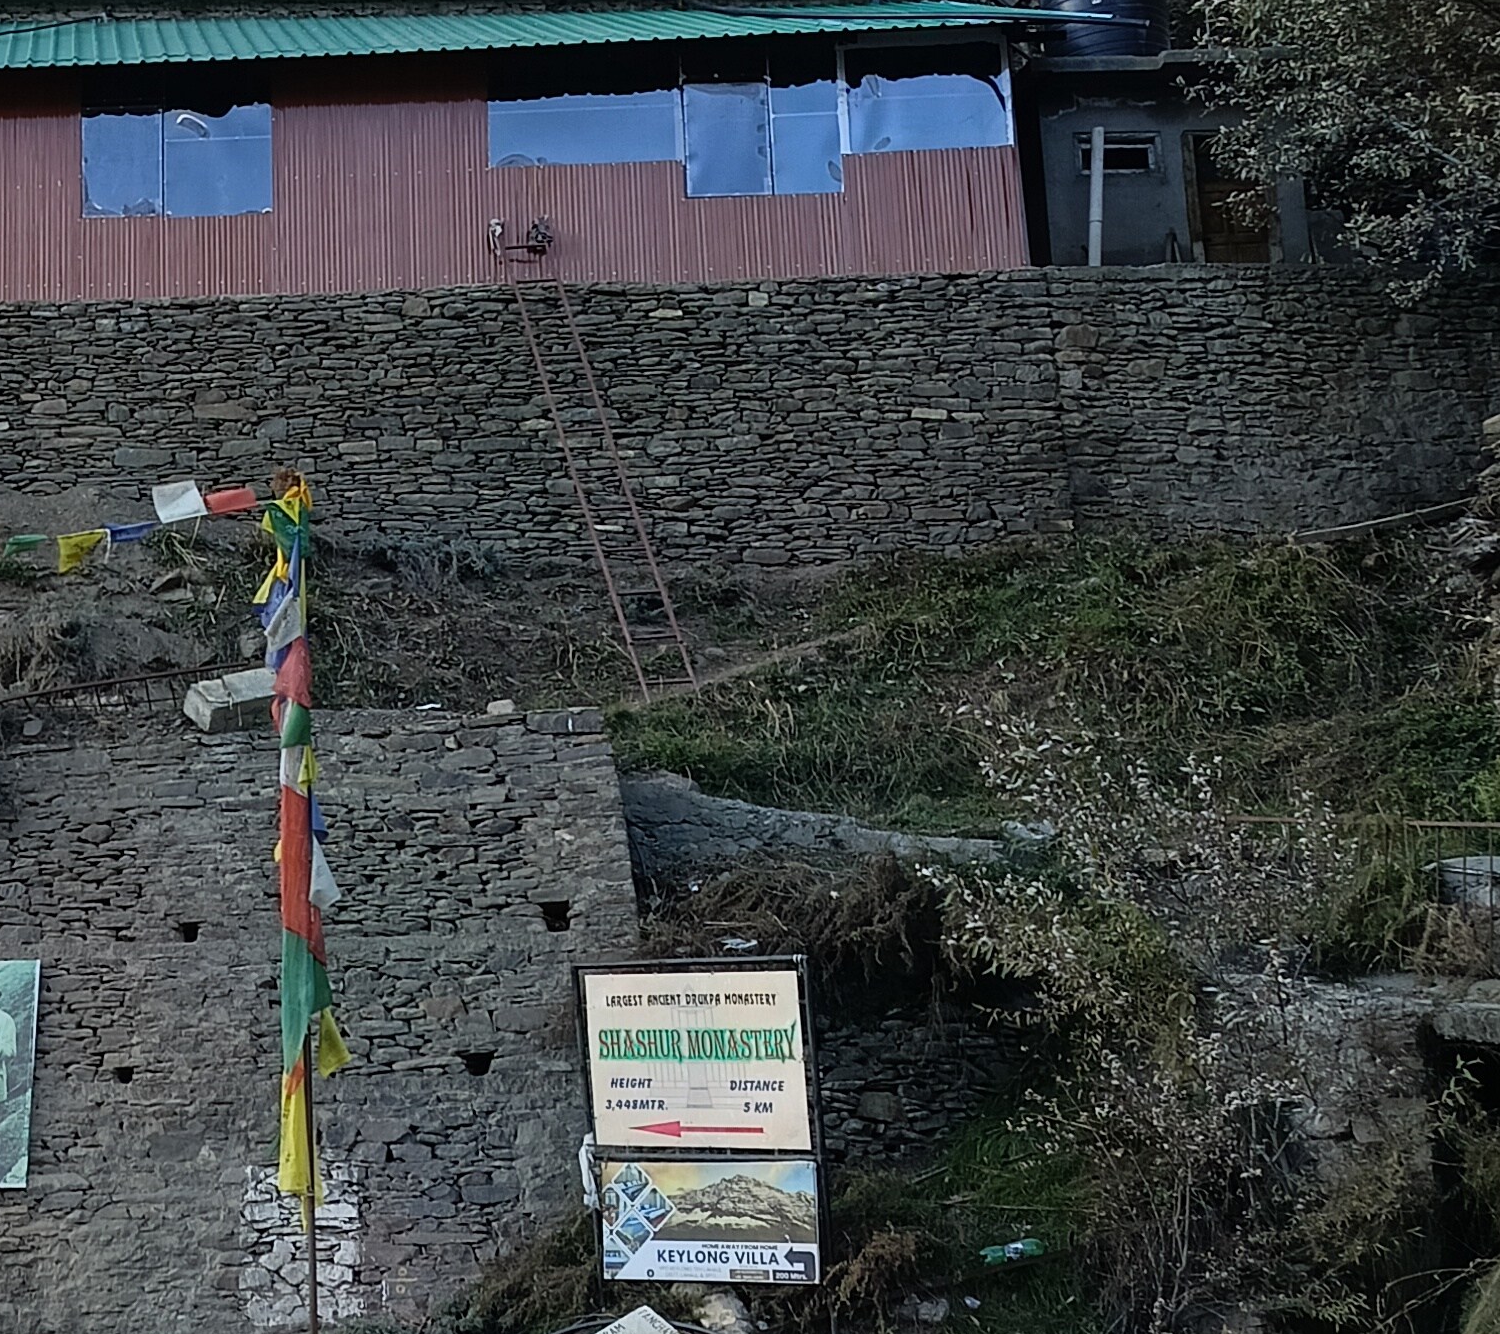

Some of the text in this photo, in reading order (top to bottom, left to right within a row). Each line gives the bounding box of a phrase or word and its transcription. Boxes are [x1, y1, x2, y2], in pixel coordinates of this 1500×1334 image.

[605, 993, 777, 1008] LARGEST ANCIENT DRUKPA MONASTERY
[598, 1019, 798, 1064] SHASHUR MONASTERY
[610, 1077, 785, 1092] HEIGHT DISTANCE
[743, 1102, 751, 1113] 5
[754, 1102, 773, 1114] KM
[657, 1249, 779, 1266] KEYLONG VILLA
